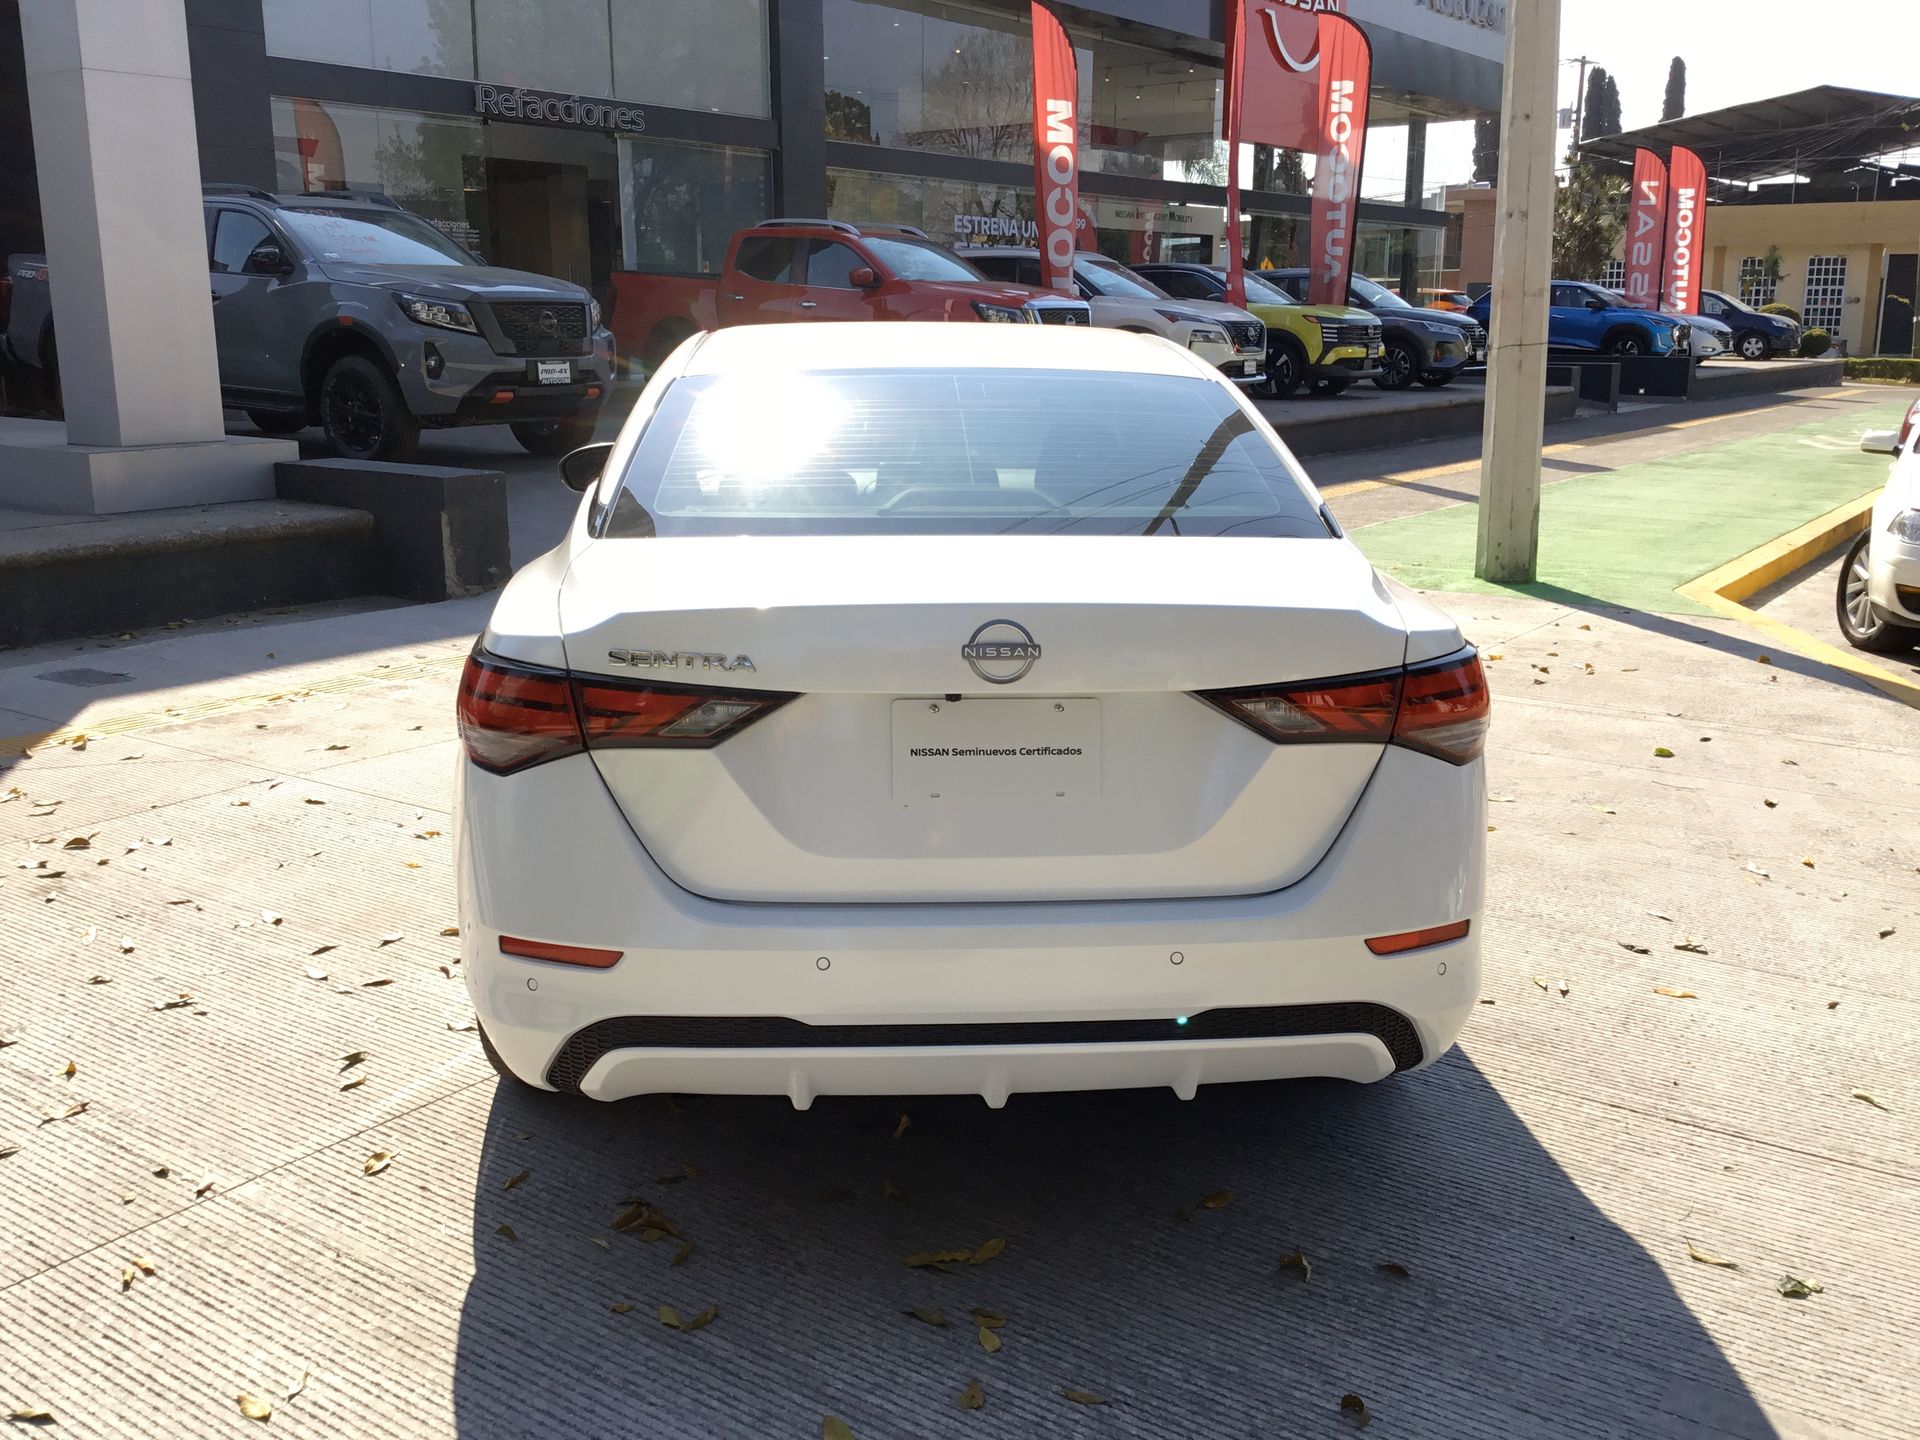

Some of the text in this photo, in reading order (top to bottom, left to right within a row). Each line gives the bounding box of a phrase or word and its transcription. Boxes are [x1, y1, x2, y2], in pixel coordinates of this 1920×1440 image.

[475, 84, 646, 132] Refacciones
[954, 214, 1018, 237] ESTRENA
[542, 377, 571, 385] AUTOCOM
[608, 648, 757, 673] SENTRA
[964, 647, 1039, 657] NISSAN
[910, 746, 1082, 757] NISSAN Seminuevos Certificados
